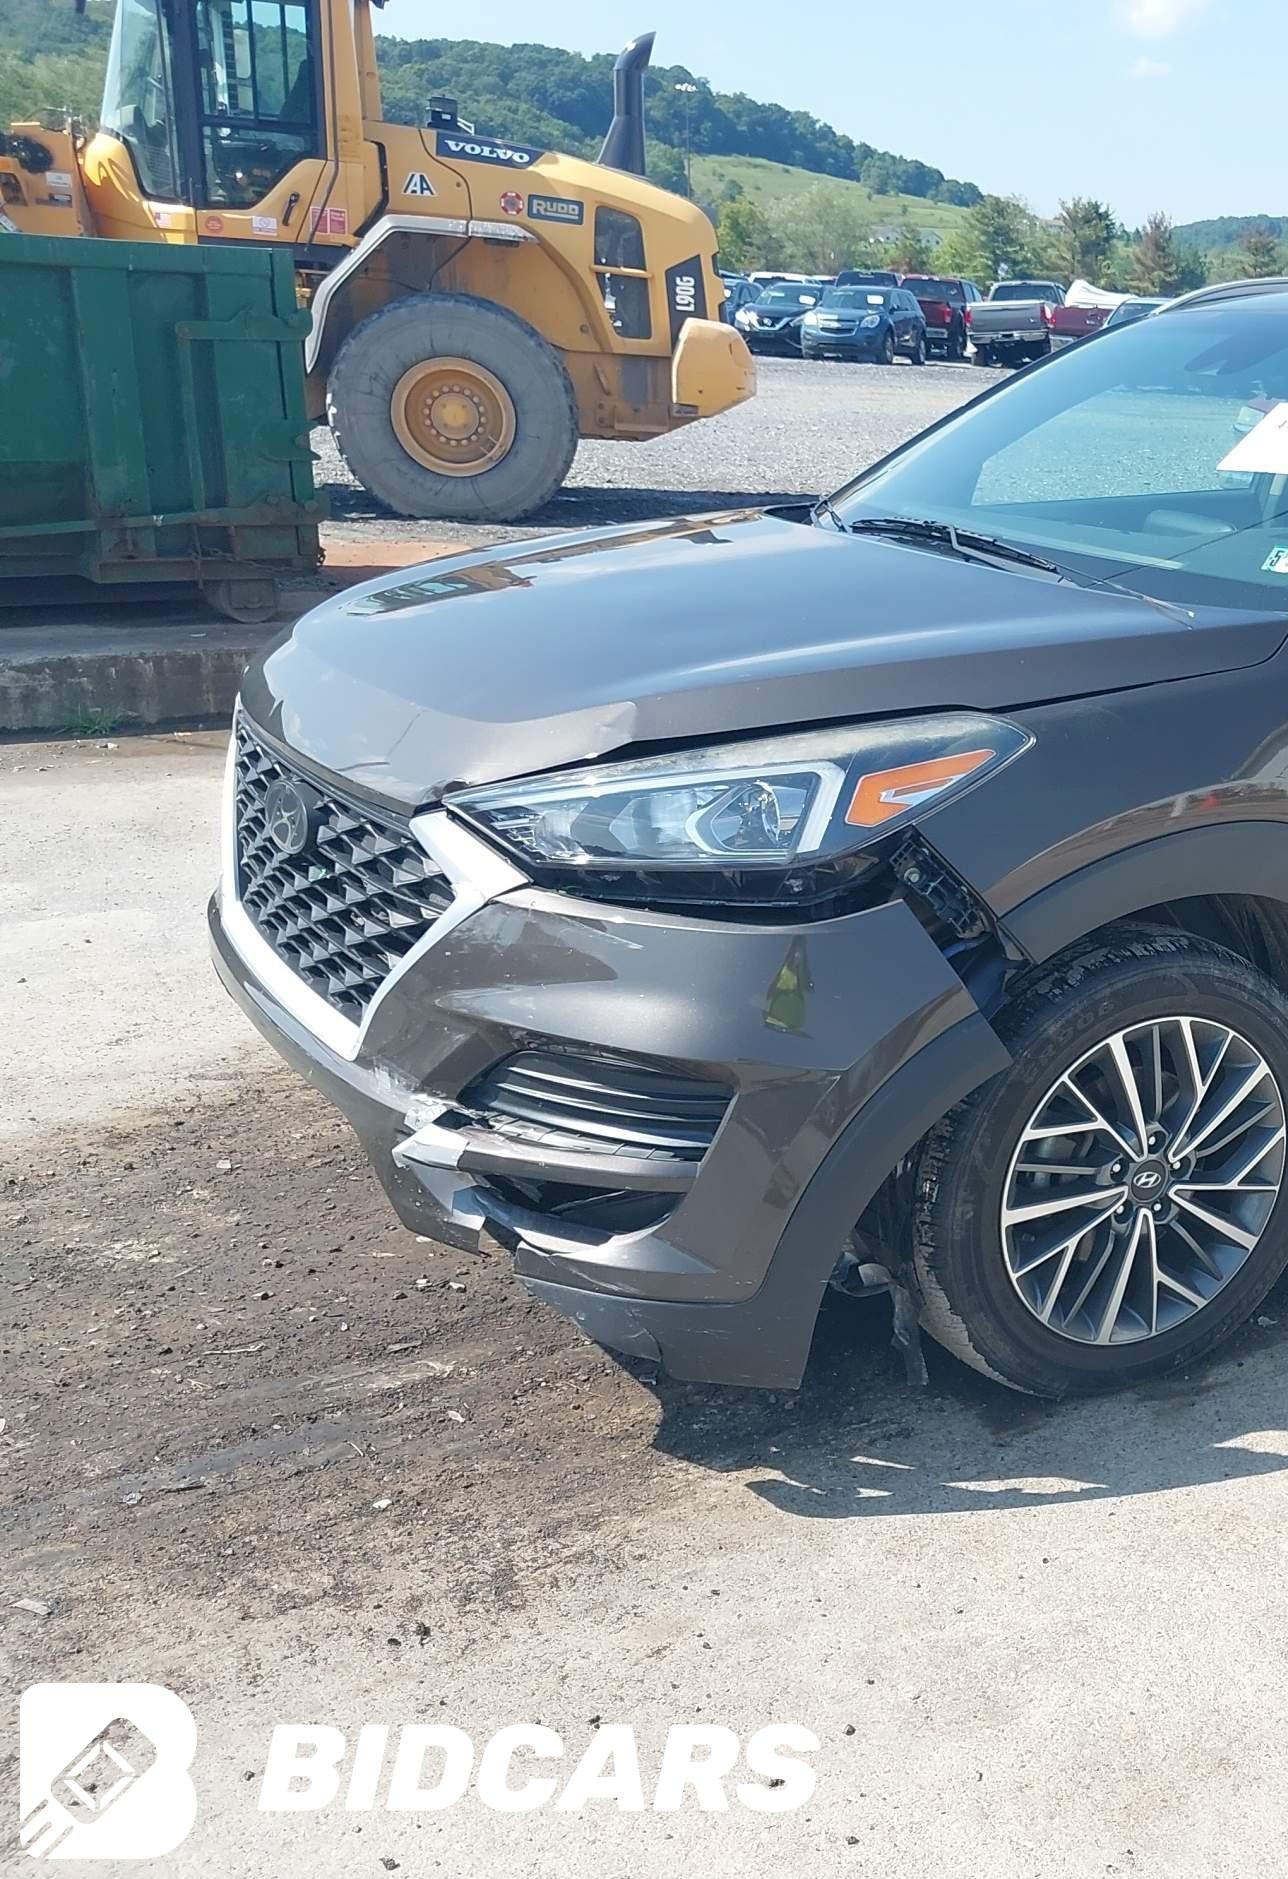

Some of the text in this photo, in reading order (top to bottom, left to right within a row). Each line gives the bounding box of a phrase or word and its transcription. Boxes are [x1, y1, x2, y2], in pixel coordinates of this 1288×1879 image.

[444, 140, 530, 164] VOLVO
[532, 199, 580, 216] RUDD
[675, 275, 696, 312] L90G
